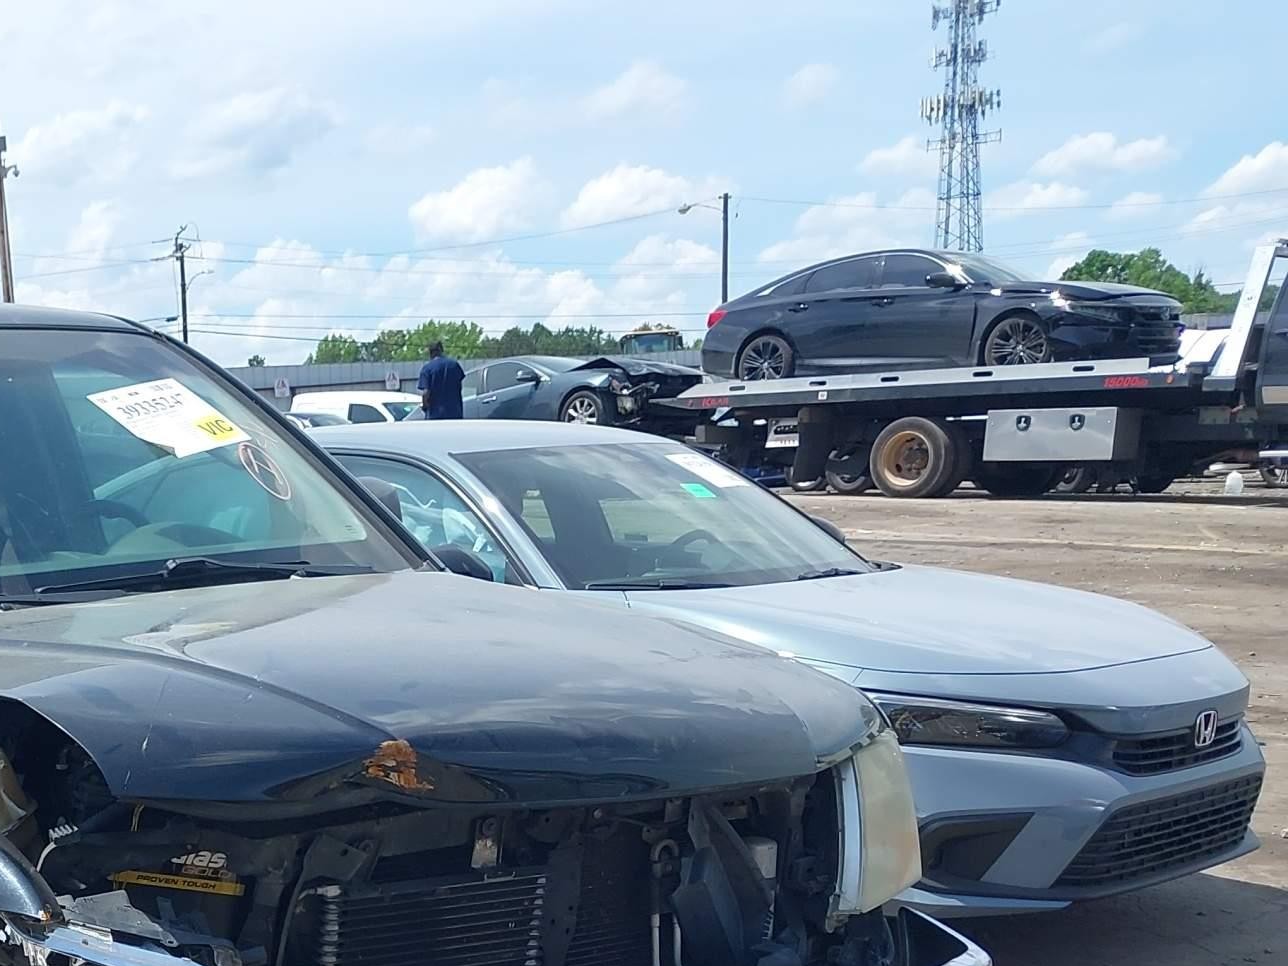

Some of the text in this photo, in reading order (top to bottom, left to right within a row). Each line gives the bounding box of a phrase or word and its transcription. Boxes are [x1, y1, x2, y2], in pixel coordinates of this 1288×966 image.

[197, 419, 234, 436] VIC
[136, 874, 217, 890] PROVEN TOUGH
